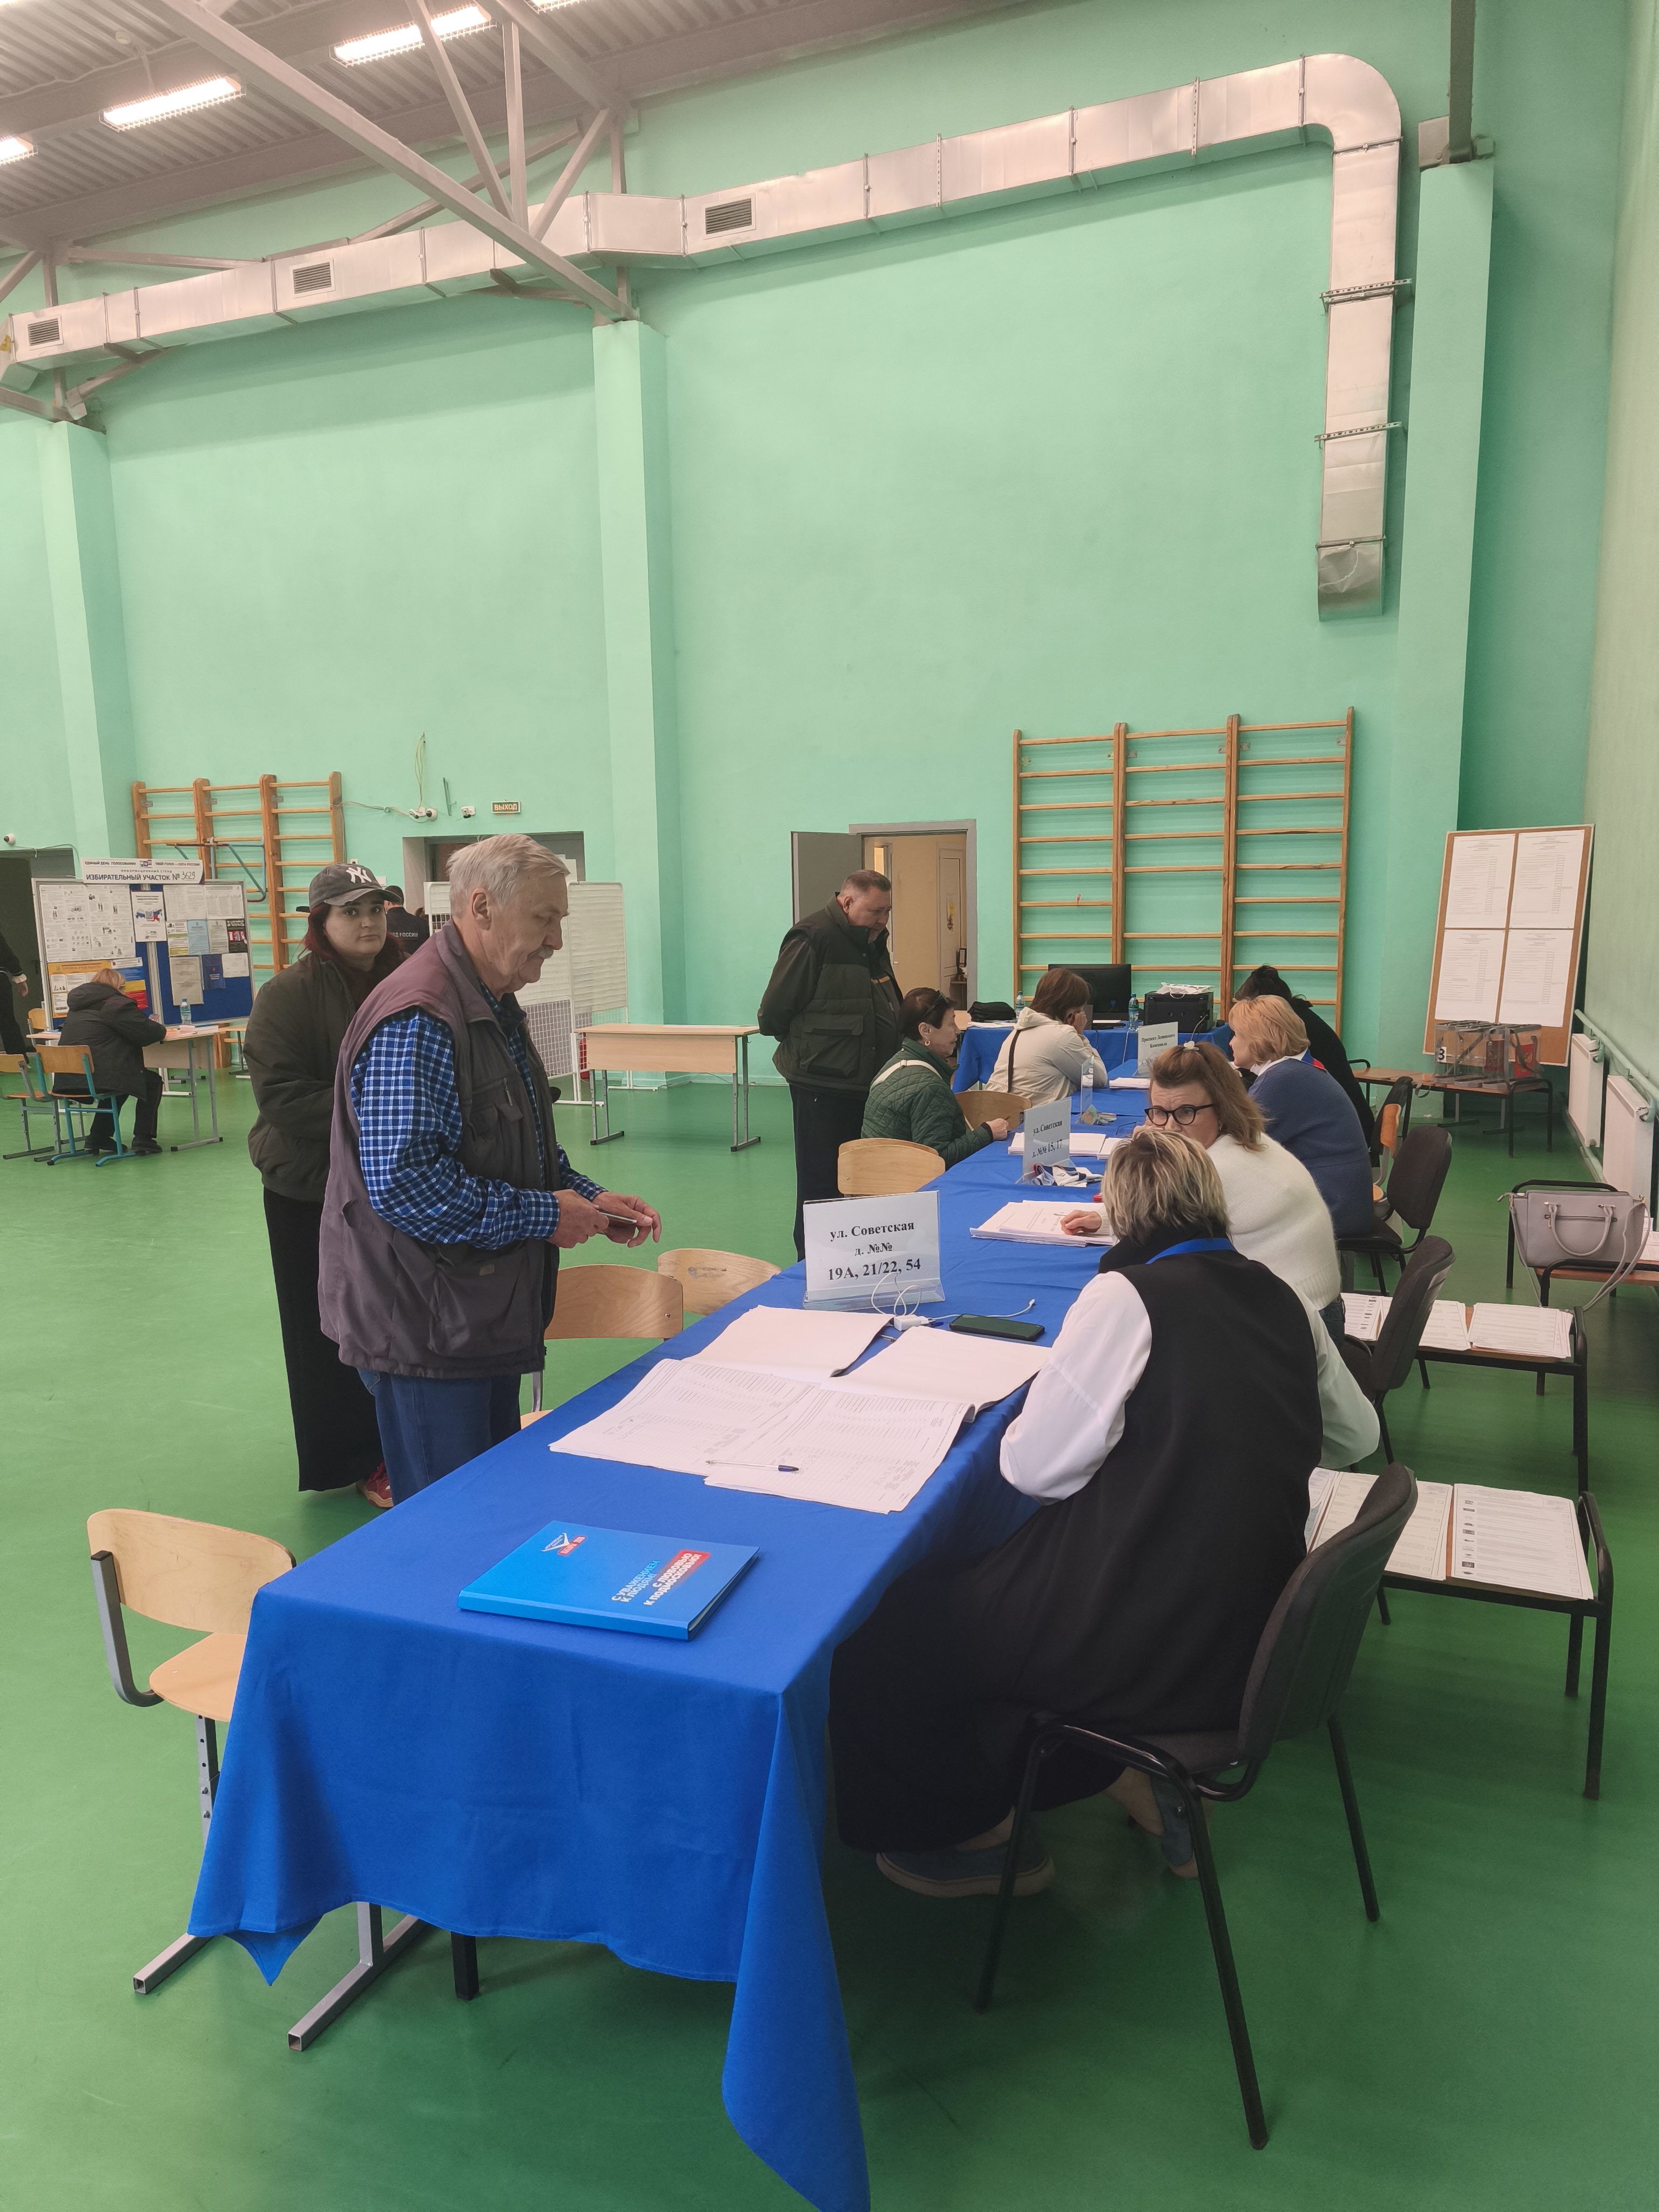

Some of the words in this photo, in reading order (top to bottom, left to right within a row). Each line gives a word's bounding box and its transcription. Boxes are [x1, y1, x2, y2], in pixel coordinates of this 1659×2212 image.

[346, 866, 372, 884] NY
[1040, 1120, 1062, 1132] Советская
[1057, 1138, 1062, 1149] 17
[830, 1230, 848, 1242] ул.
[851, 1222, 914, 1237] Советская
[854, 1247, 864, 1256] д.
[828, 1267, 859, 1280] 19А,
[862, 1260, 902, 1276] 21/22,
[906, 1258, 921, 1271] 54
[618, 1560, 661, 1596] УВАЖЕНИЕМ
[649, 1554, 702, 1600] ПОДМОСКОВЬЮ!
[657, 1553, 692, 1583] ЛЮБОВЬЮ
